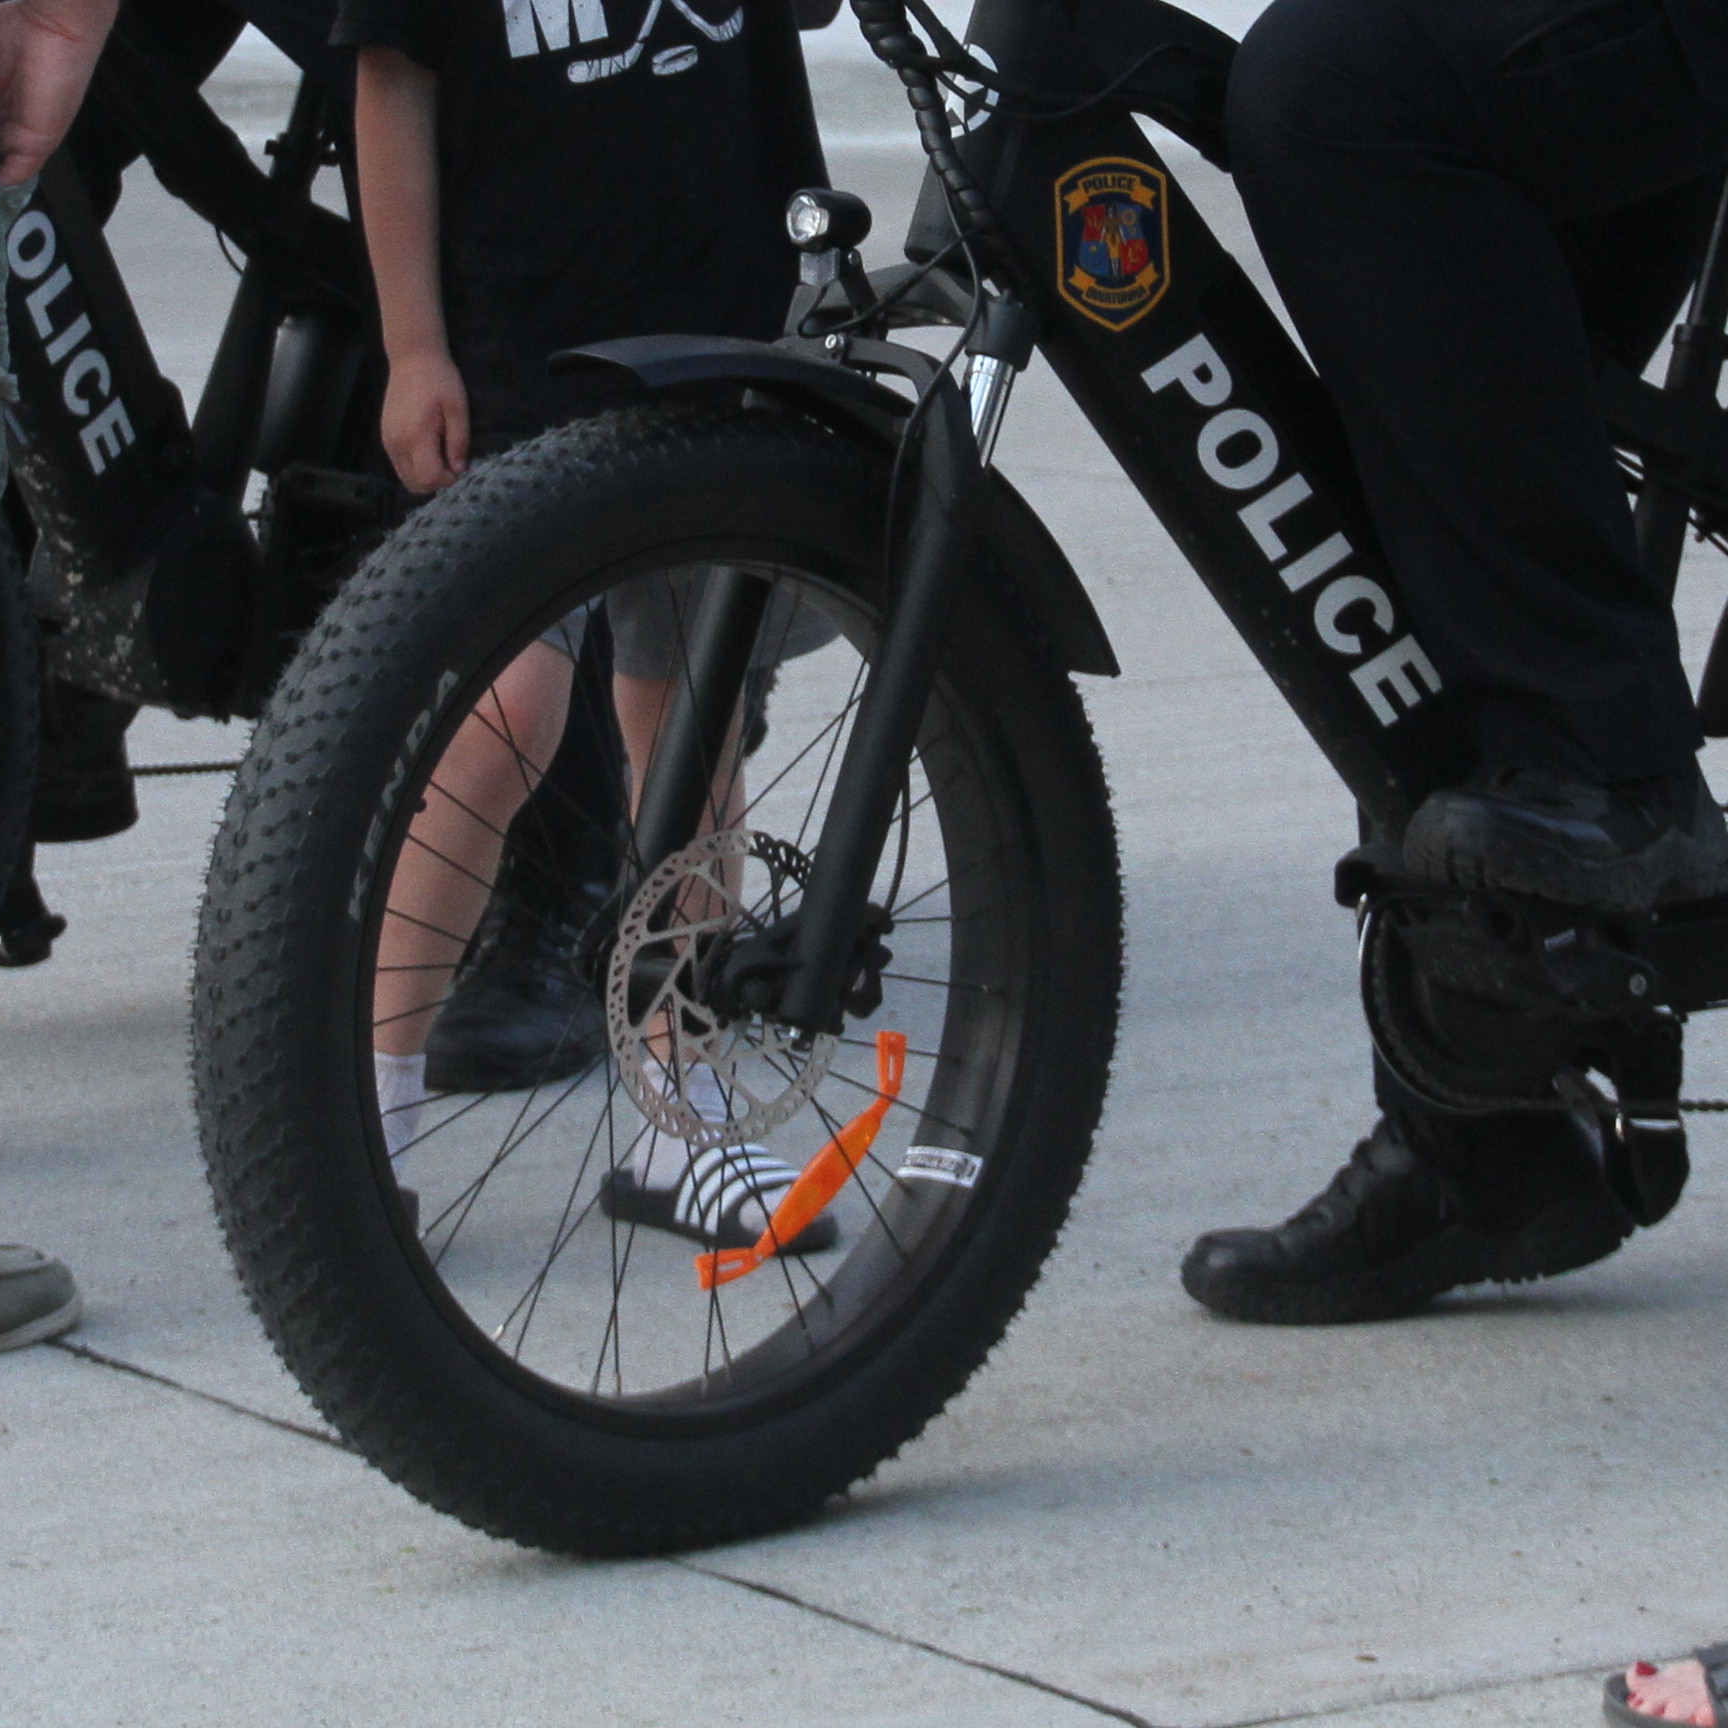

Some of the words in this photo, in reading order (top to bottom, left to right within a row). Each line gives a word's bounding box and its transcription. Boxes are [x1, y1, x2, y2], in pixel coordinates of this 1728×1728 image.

[1084, 174, 1137, 192] POLICE
[7, 209, 137, 476] OLICE
[1140, 332, 1444, 728] POLICE
